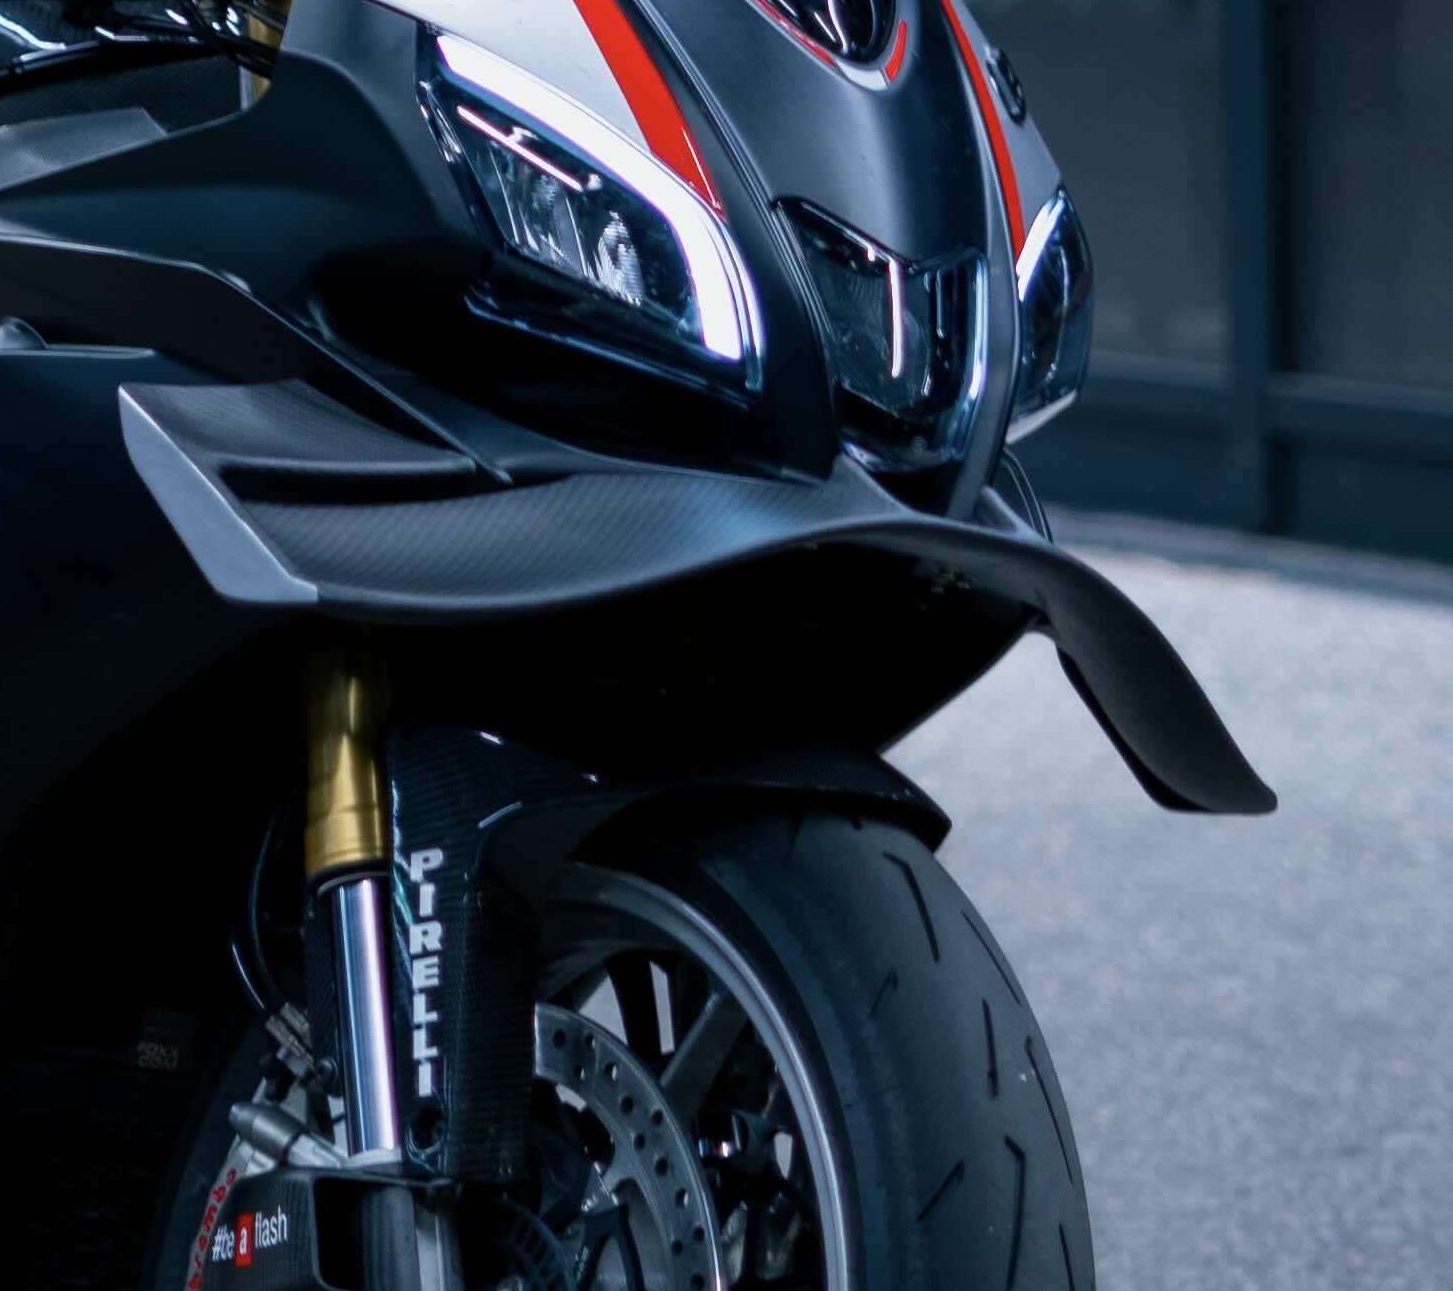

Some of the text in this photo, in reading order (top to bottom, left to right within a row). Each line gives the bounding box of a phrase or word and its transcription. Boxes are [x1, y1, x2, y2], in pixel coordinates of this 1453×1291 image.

[408, 848, 444, 1099] PIRELLI
[212, 1222, 235, 1263] #be
[254, 1203, 289, 1251] flash
